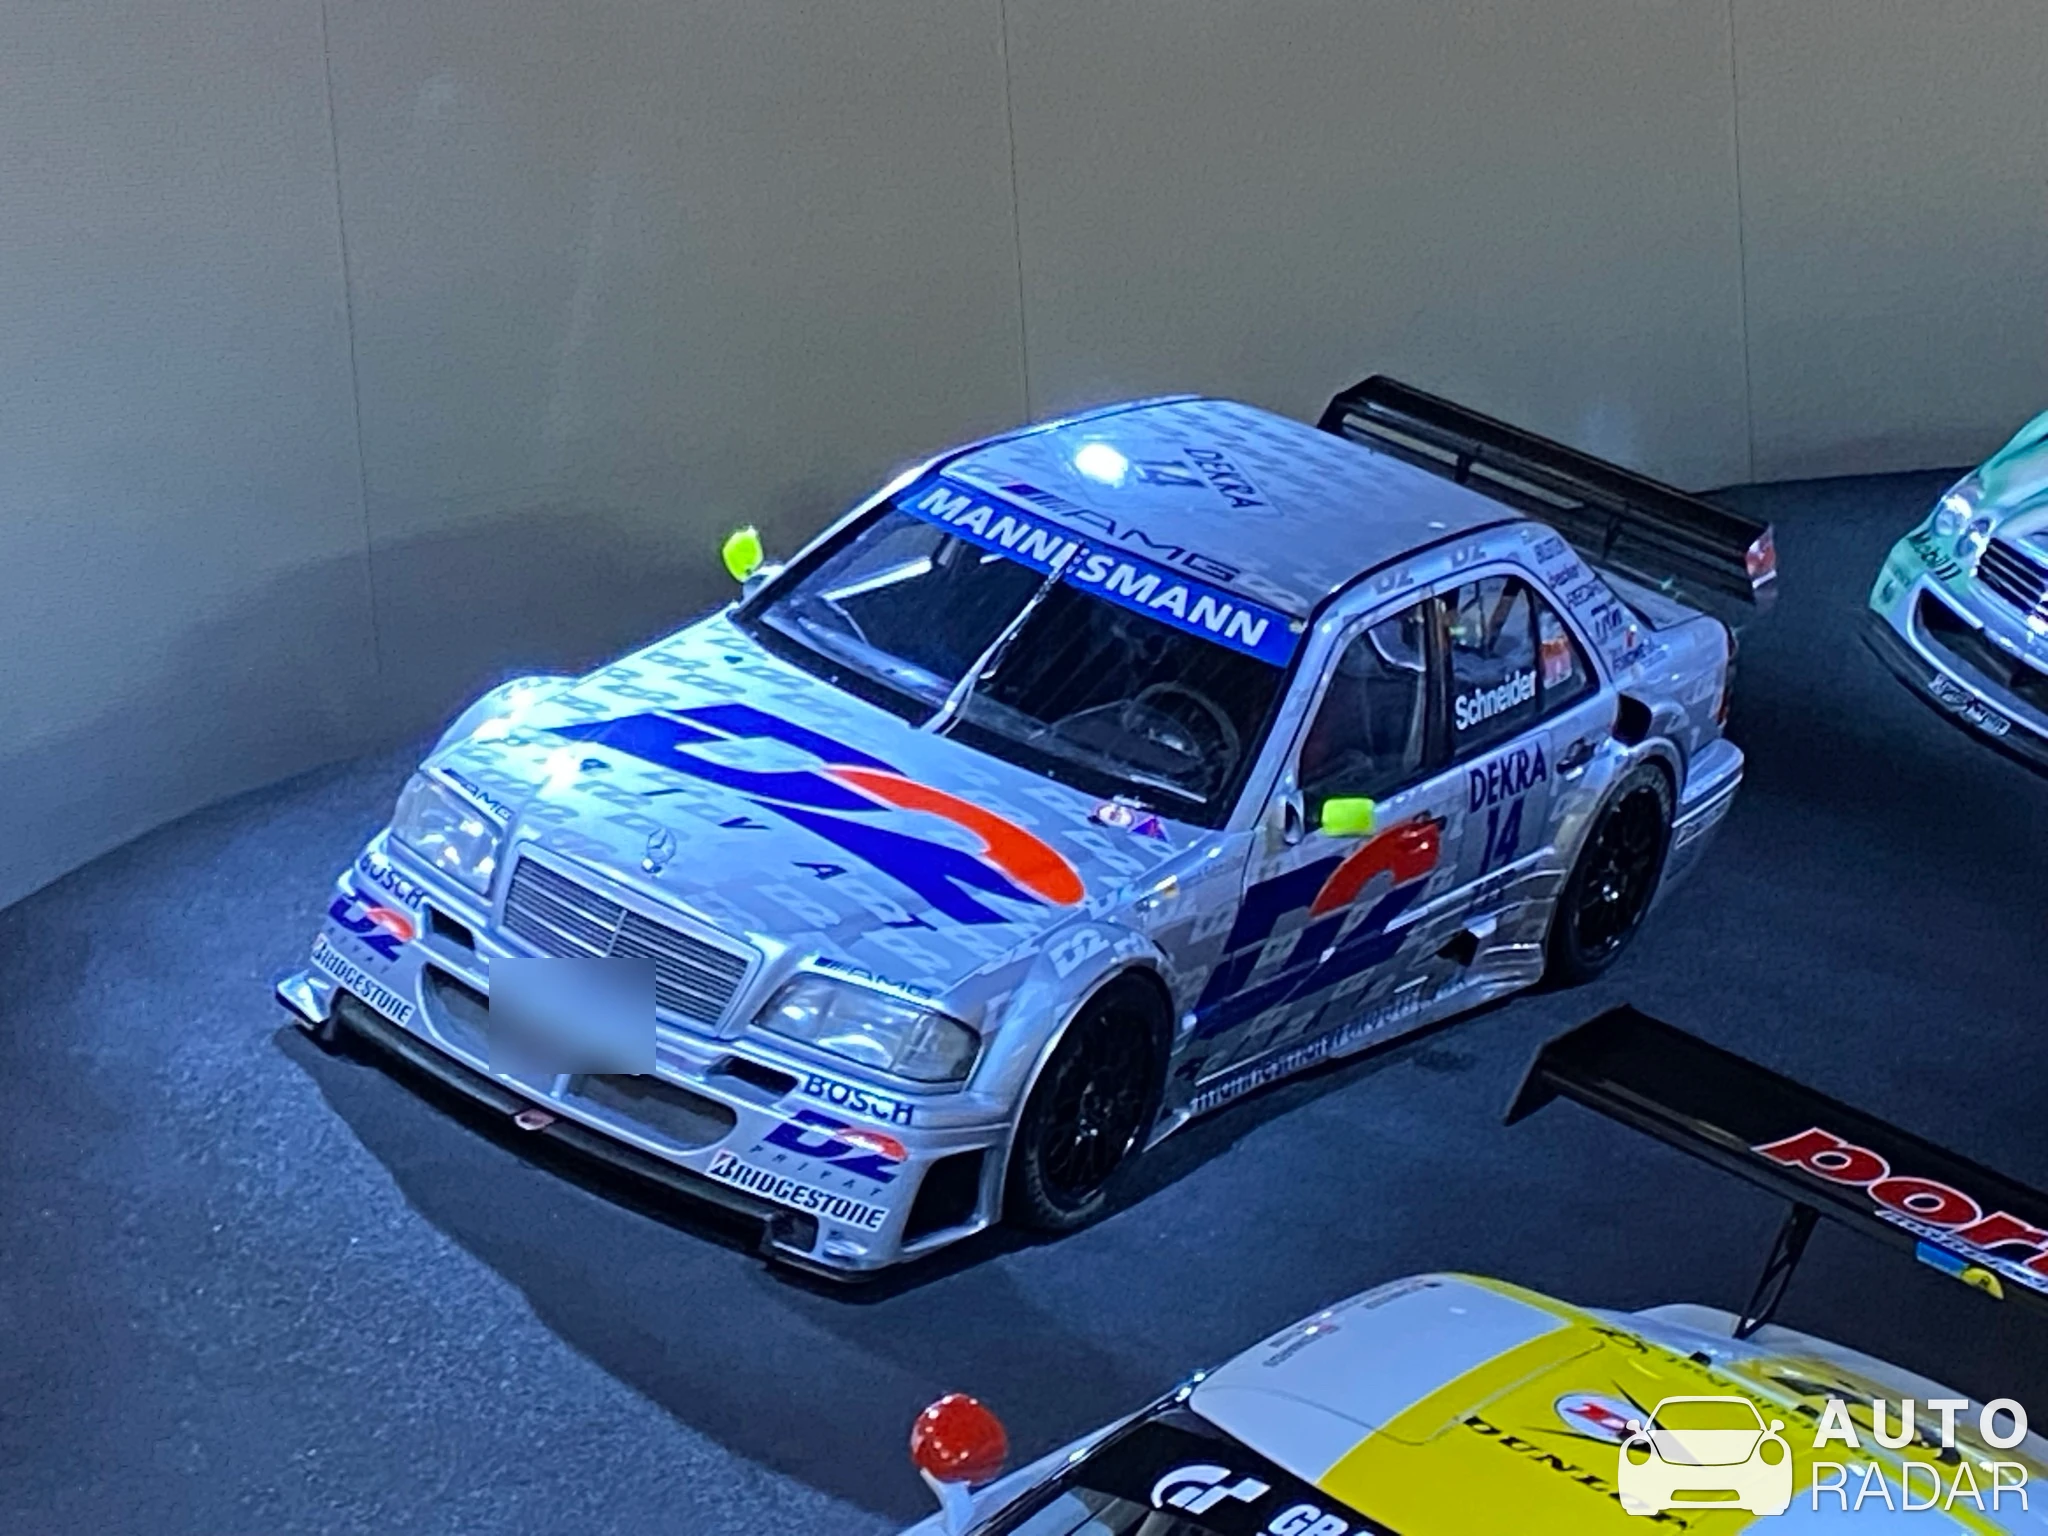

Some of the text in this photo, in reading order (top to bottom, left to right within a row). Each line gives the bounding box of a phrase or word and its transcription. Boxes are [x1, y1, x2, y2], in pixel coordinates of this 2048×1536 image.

[1183, 448, 1265, 508] DEKRA
[1454, 670, 1537, 731] Schneider
[1467, 741, 1547, 814] DEKRA
[1478, 796, 1525, 877] 14
[312, 936, 414, 1024] BRIDGESTONE
[803, 1074, 915, 1126] BOSCH
[708, 1153, 887, 1229] BRIDGESTONE
